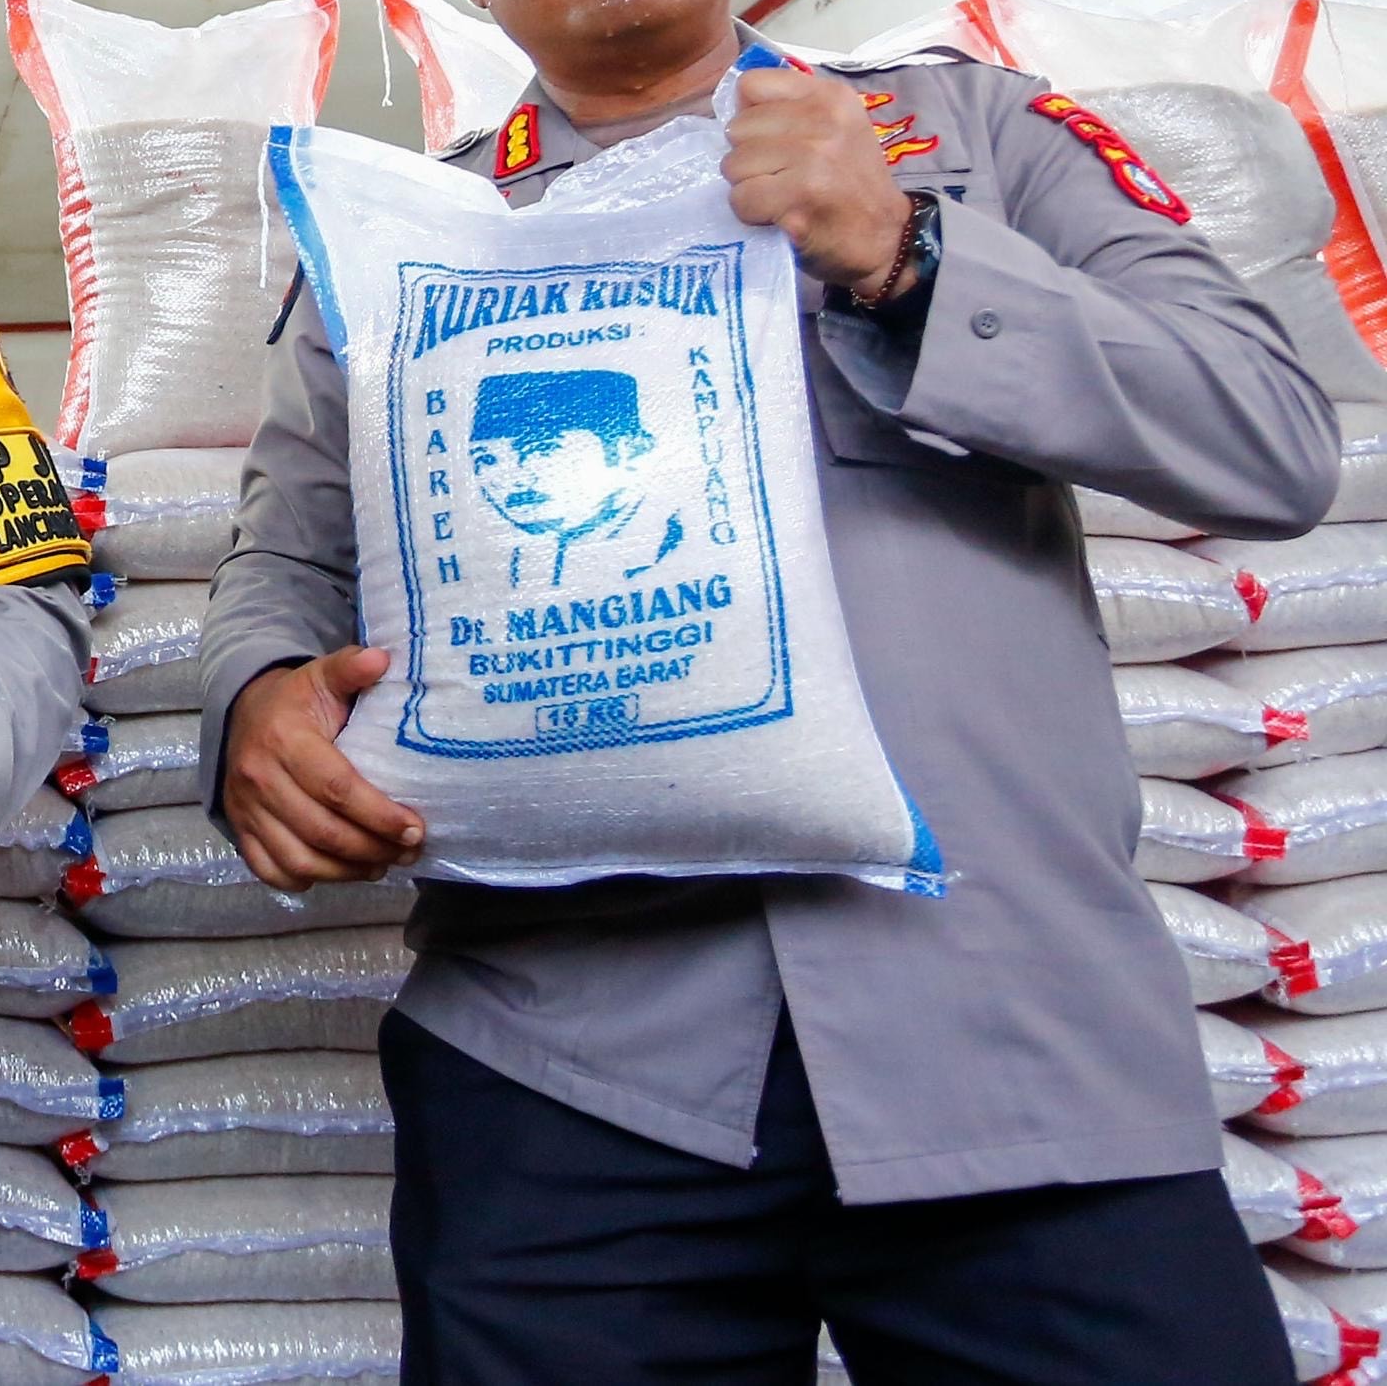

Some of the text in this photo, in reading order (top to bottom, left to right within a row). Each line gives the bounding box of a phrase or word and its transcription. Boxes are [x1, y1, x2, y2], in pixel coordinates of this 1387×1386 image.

[412, 280, 571, 360] KURIAK
[486, 322, 633, 357] PRODUKSI
[425, 388, 461, 585] BAREH
[507, 573, 733, 643] MANGIANG
[469, 620, 714, 677] BUKITTINGGI
[483, 653, 697, 705] SUMATERA BARAT
